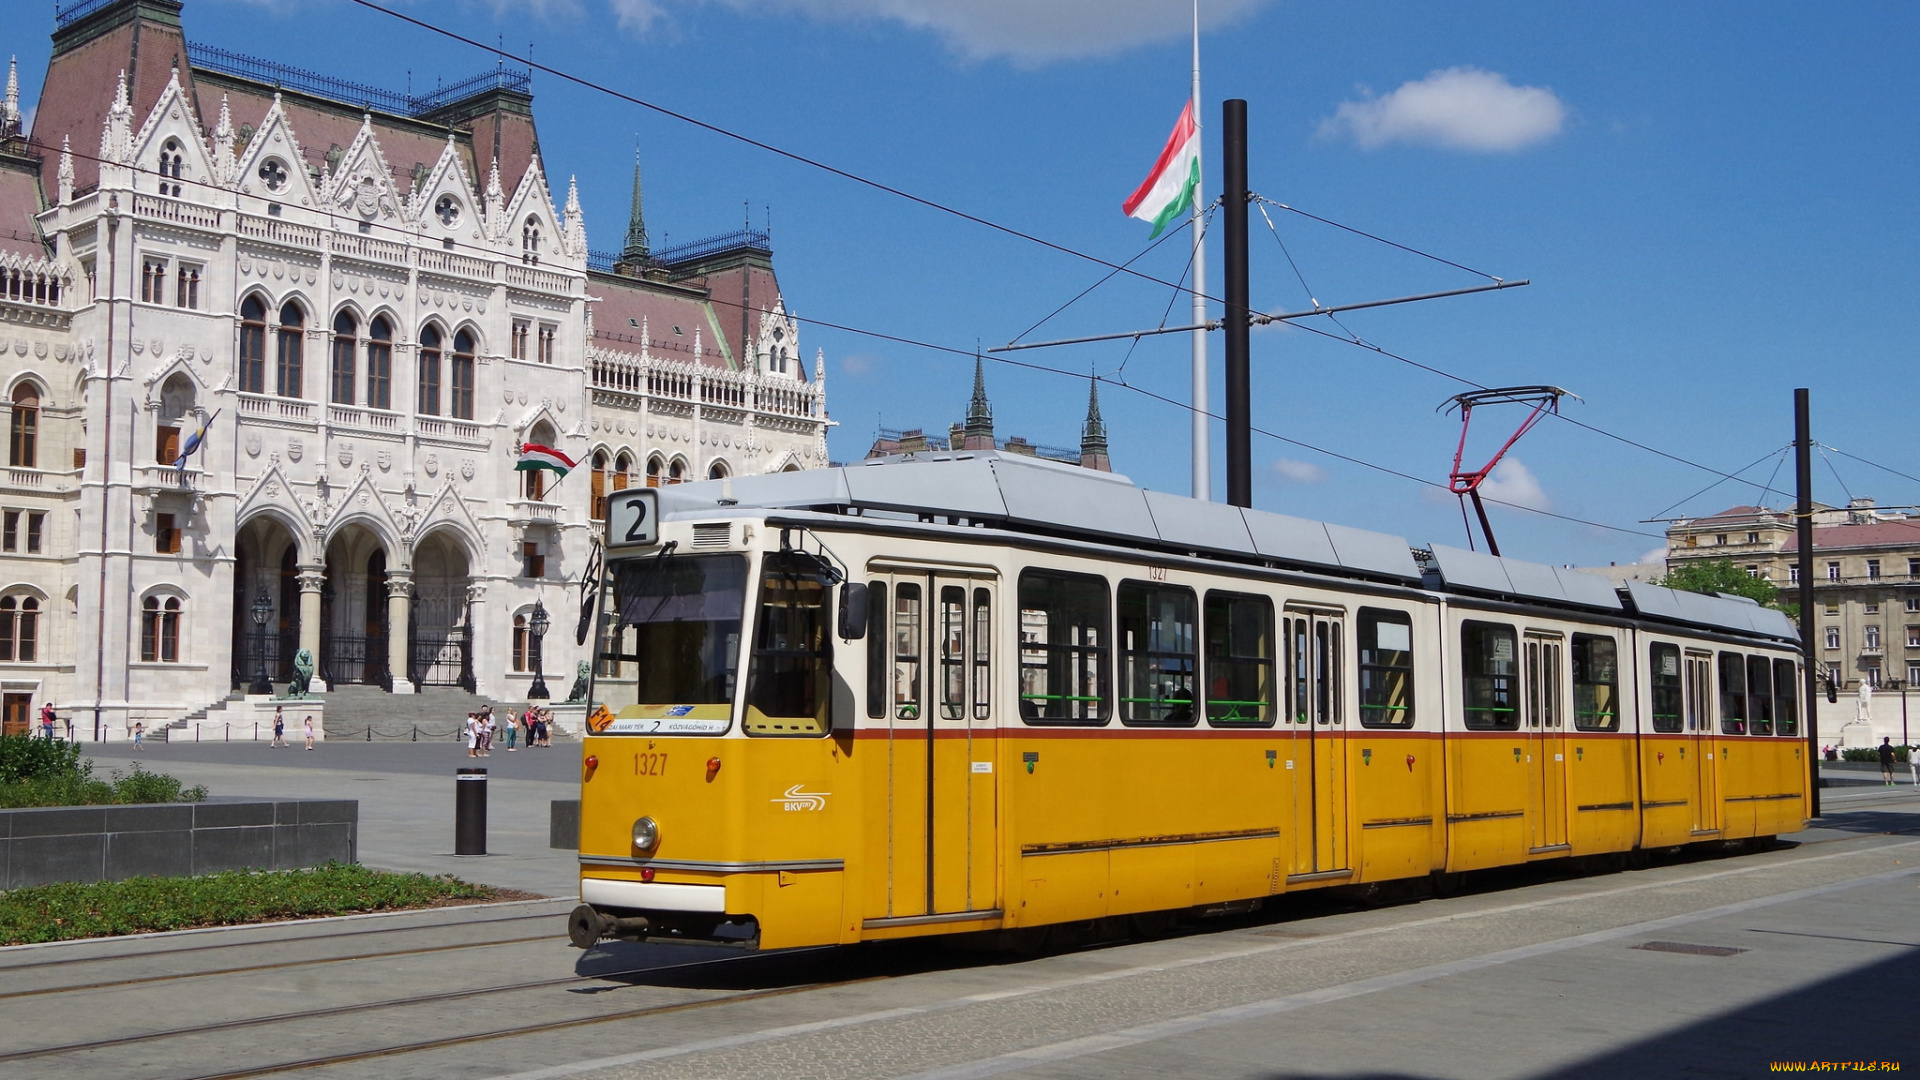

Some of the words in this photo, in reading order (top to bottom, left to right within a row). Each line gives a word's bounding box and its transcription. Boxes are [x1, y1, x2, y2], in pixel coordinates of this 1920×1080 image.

[625, 500, 647, 542] 2
[1149, 565, 1167, 581] 1327
[590, 706, 612, 731] F14
[650, 720, 661, 732] 2
[634, 753, 668, 776] 1327
[784, 802, 802, 811] BKV
